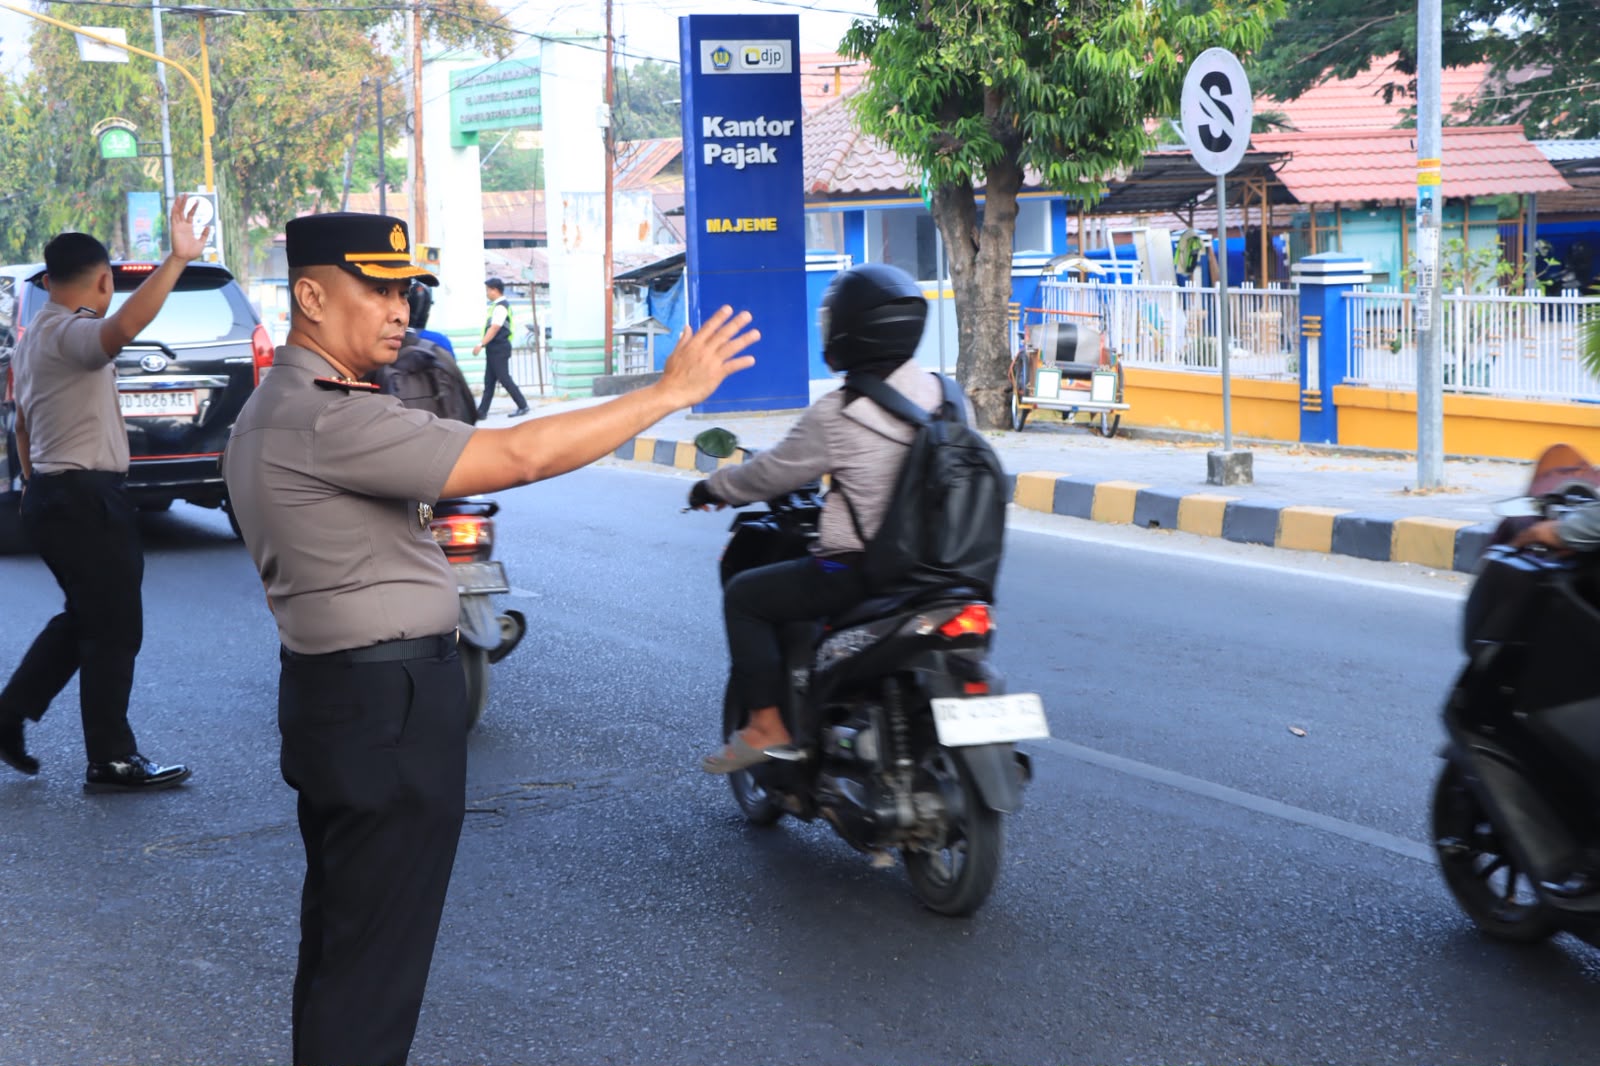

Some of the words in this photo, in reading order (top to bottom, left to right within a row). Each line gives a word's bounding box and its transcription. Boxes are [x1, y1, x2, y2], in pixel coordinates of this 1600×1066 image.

[761, 49, 781, 65] djp
[702, 116, 795, 138] Kantor
[703, 142, 778, 170] Pajak
[706, 218, 778, 233] MAJENE
[135, 393, 168, 408] 1626
